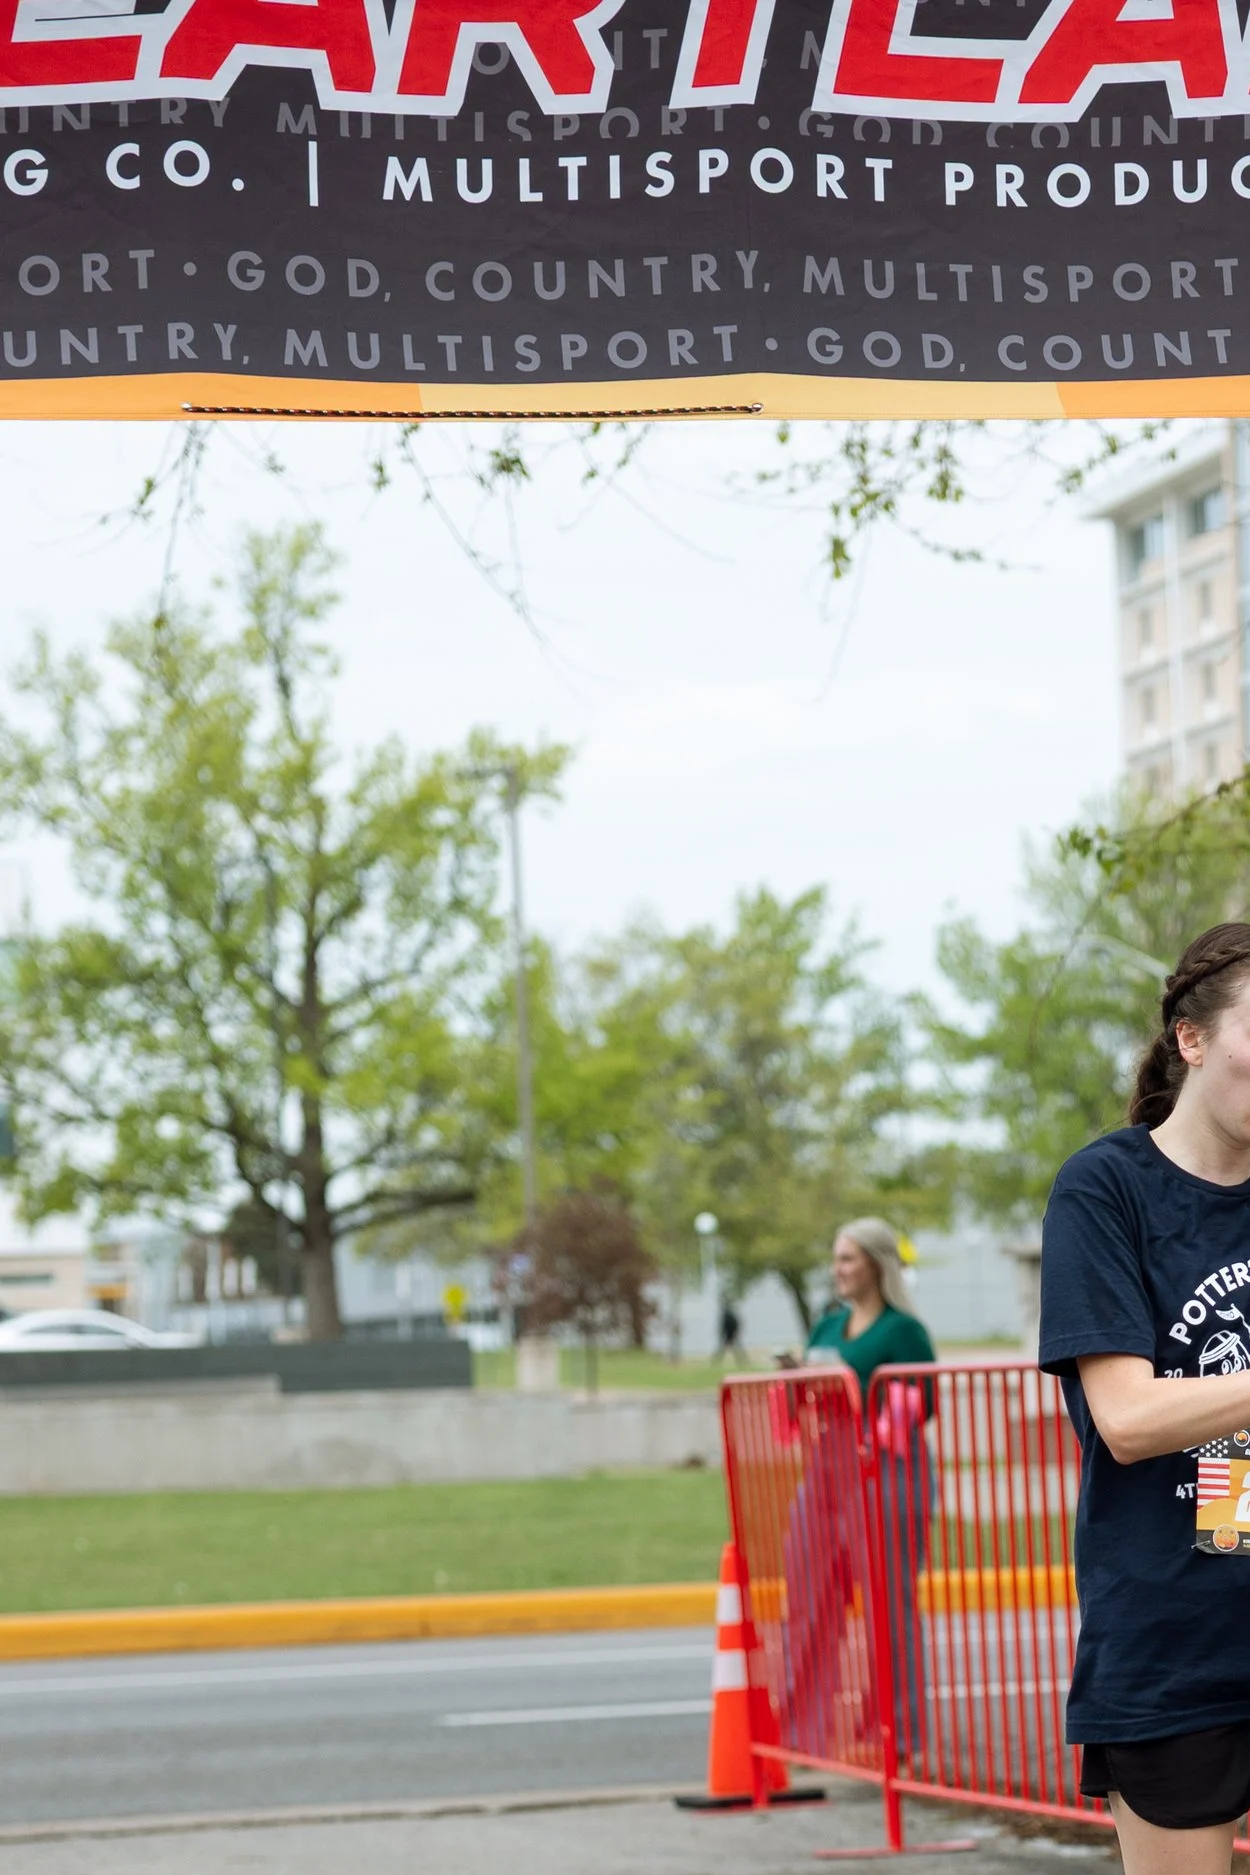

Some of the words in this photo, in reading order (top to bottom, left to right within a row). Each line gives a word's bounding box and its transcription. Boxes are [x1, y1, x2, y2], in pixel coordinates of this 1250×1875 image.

[105, 140, 245, 192] CO.
[383, 148, 894, 204] MULTISPORT
[226, 250, 392, 303] GOD,
[424, 250, 772, 301] COUNTRY,
[802, 256, 1242, 303] MULTISPORT
[283, 324, 741, 374] MULTISPORT
[806, 327, 967, 373] GOD,
[1175, 1483, 1198, 1499] 4T
